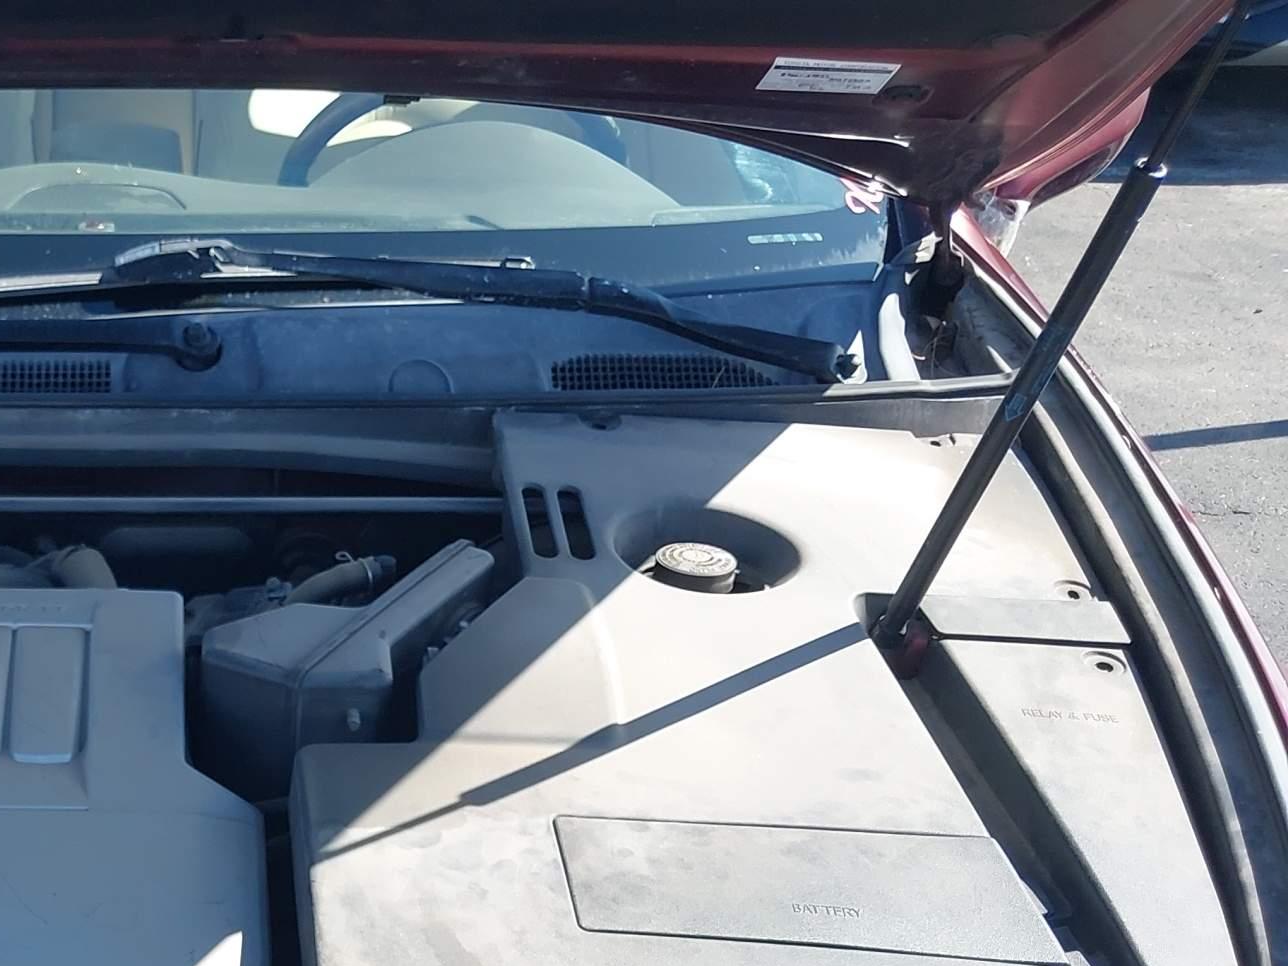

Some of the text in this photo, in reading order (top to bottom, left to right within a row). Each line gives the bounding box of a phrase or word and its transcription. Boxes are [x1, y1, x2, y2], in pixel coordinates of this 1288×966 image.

[1021, 708, 1062, 720] RELAY
[1083, 712, 1120, 723] FUSE
[791, 903, 860, 918] BATTERY
